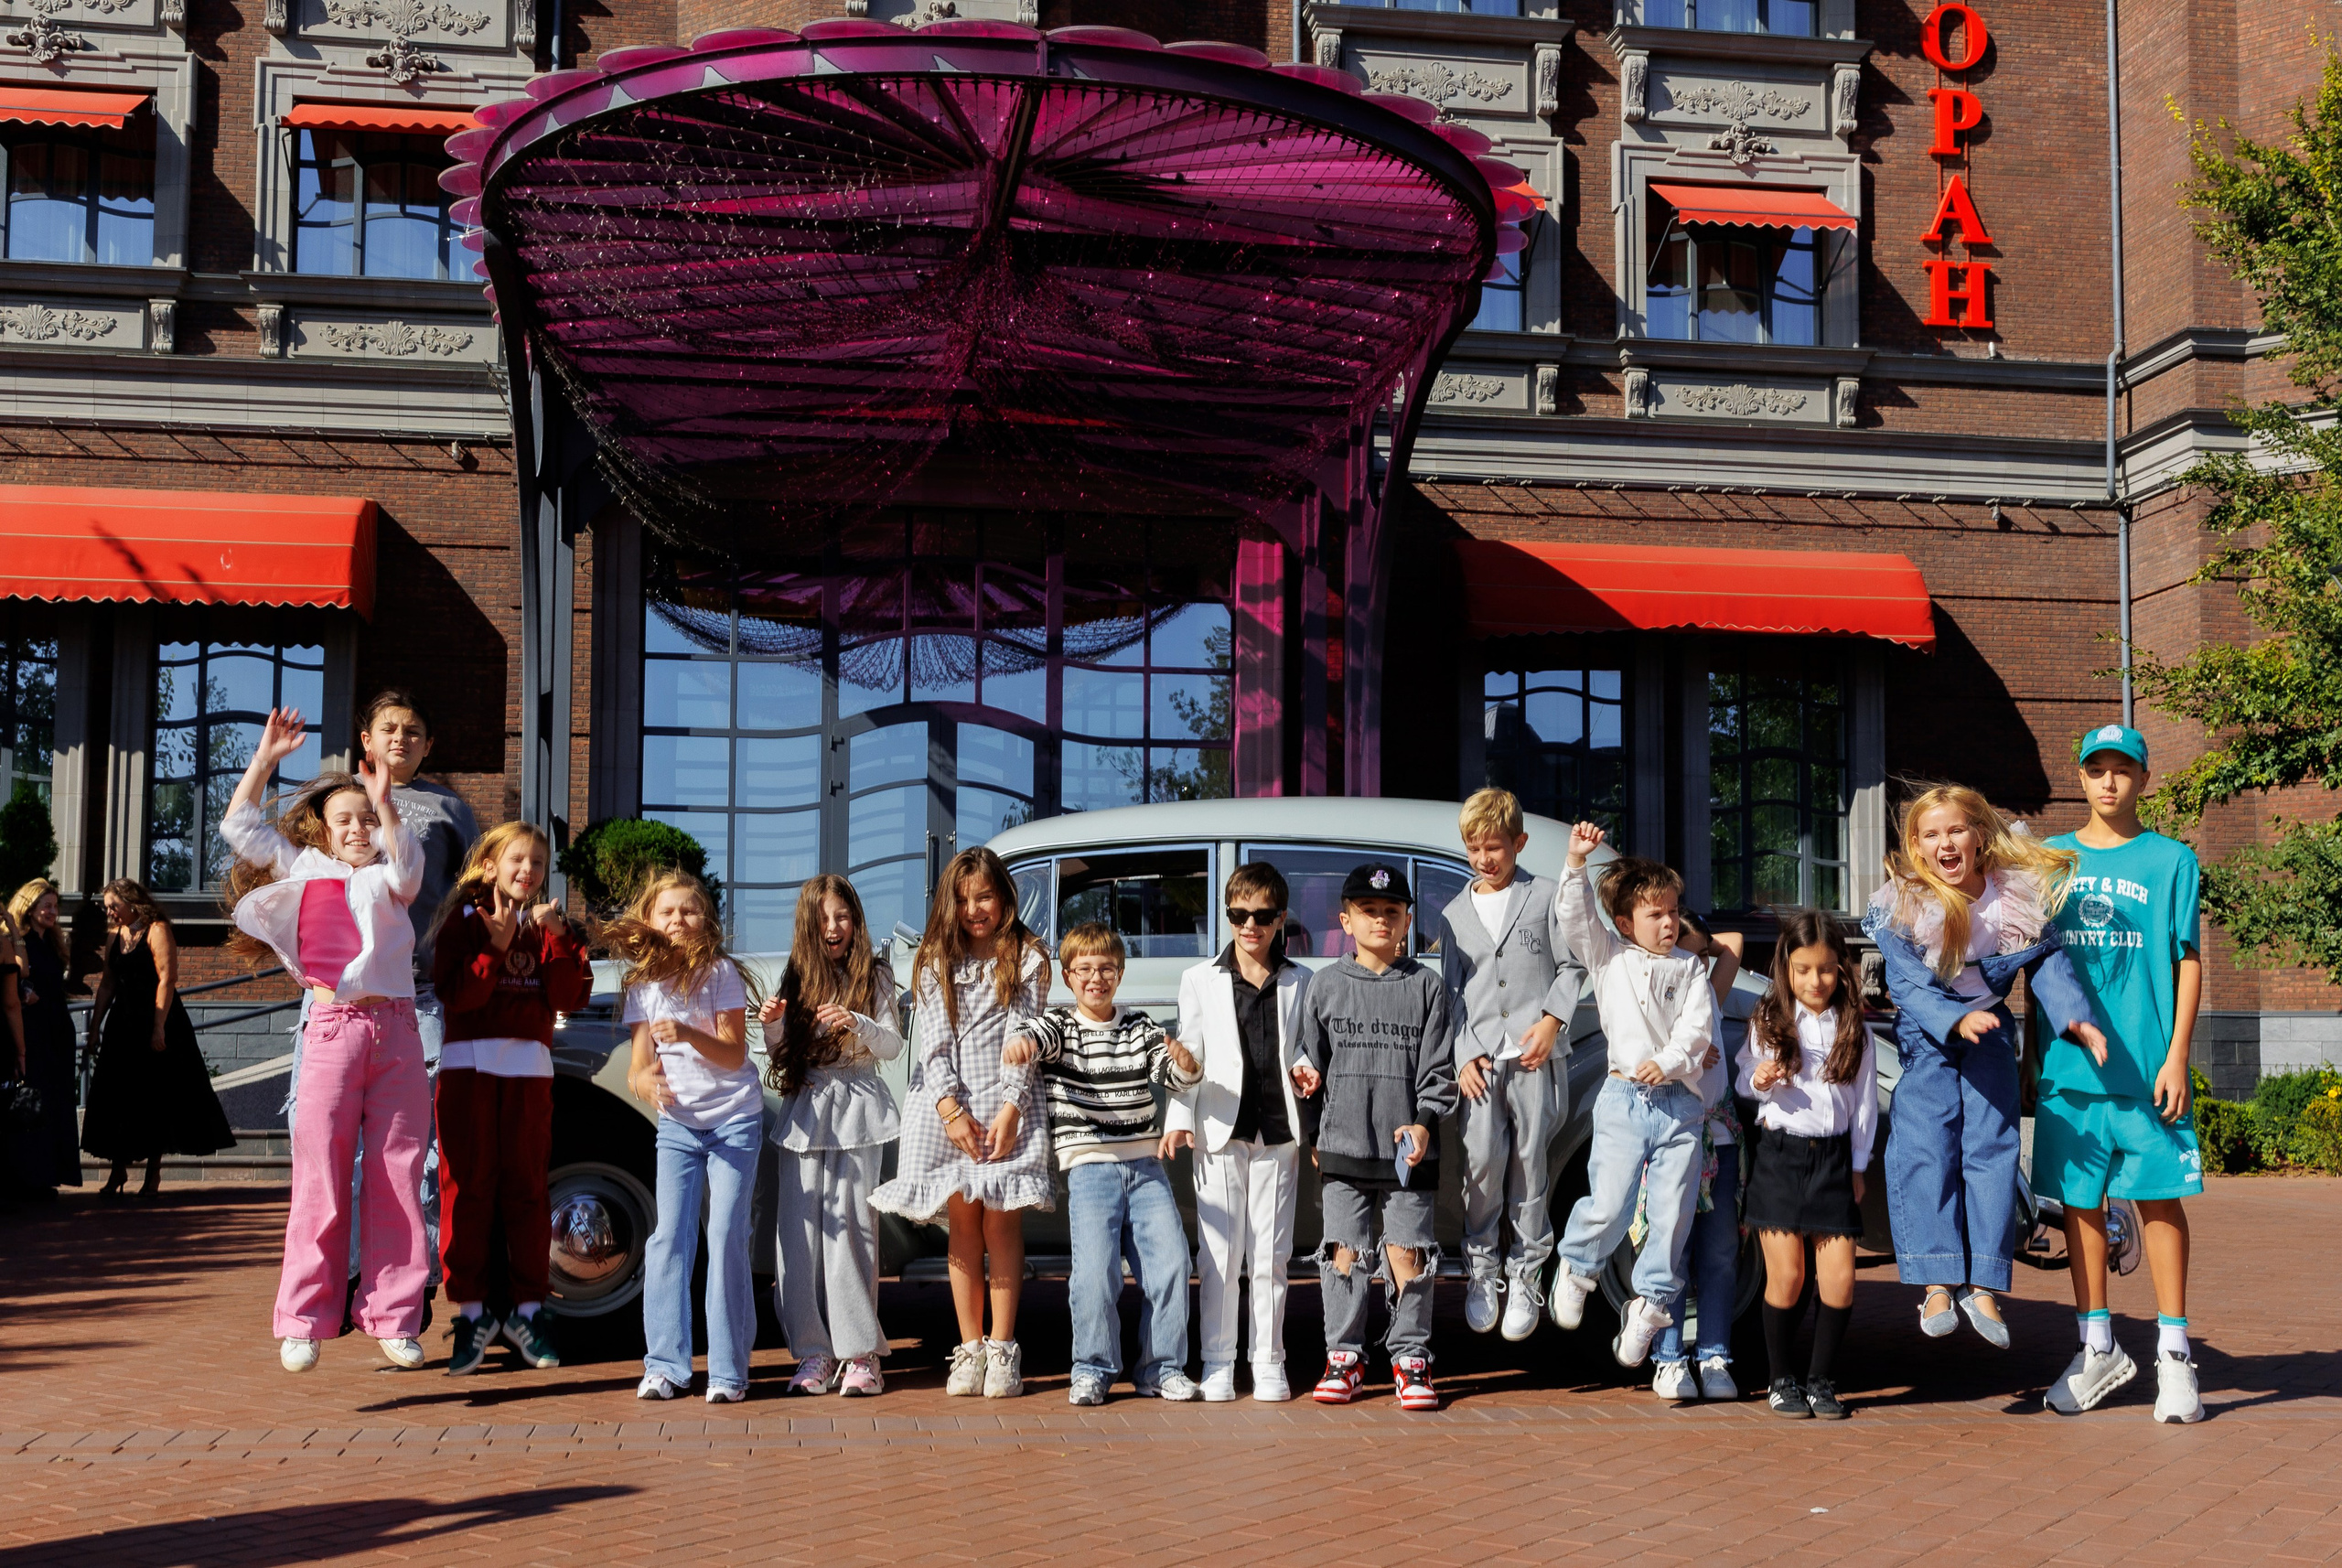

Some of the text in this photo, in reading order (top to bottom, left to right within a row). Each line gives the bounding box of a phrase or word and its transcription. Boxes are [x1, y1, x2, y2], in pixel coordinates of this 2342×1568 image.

[411, 801, 437, 816] WHERE
[2100, 876, 2112, 893] &
[2116, 878, 2148, 905] RICH
[2110, 930, 2143, 948] CLUB
[1331, 1016, 1364, 1036] The
